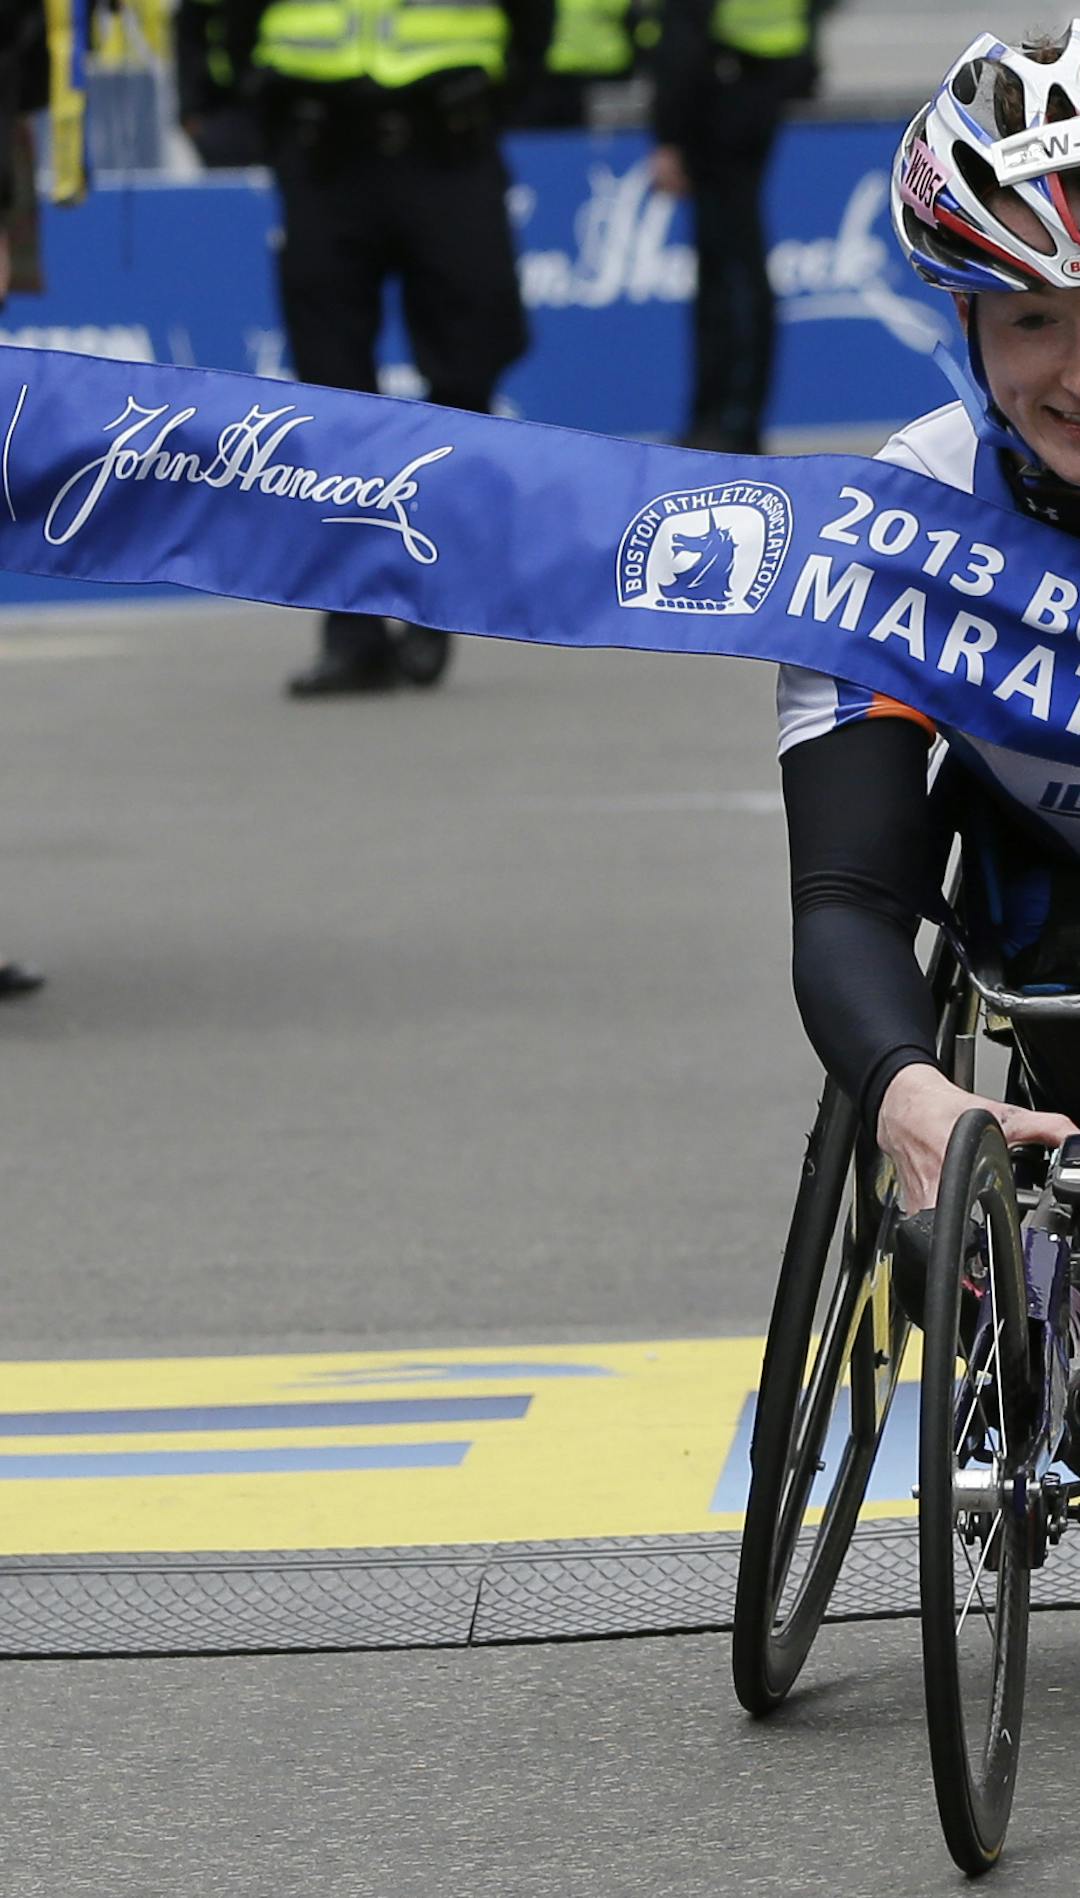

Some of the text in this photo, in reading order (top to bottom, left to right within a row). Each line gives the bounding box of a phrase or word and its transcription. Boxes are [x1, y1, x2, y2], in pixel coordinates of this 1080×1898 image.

[905, 149, 943, 209] W105
[44, 396, 454, 564] John Hancock
[624, 486, 787, 600] BOSTON ATHLETIC ASSOCIATION
[819, 486, 1006, 598] 2013
